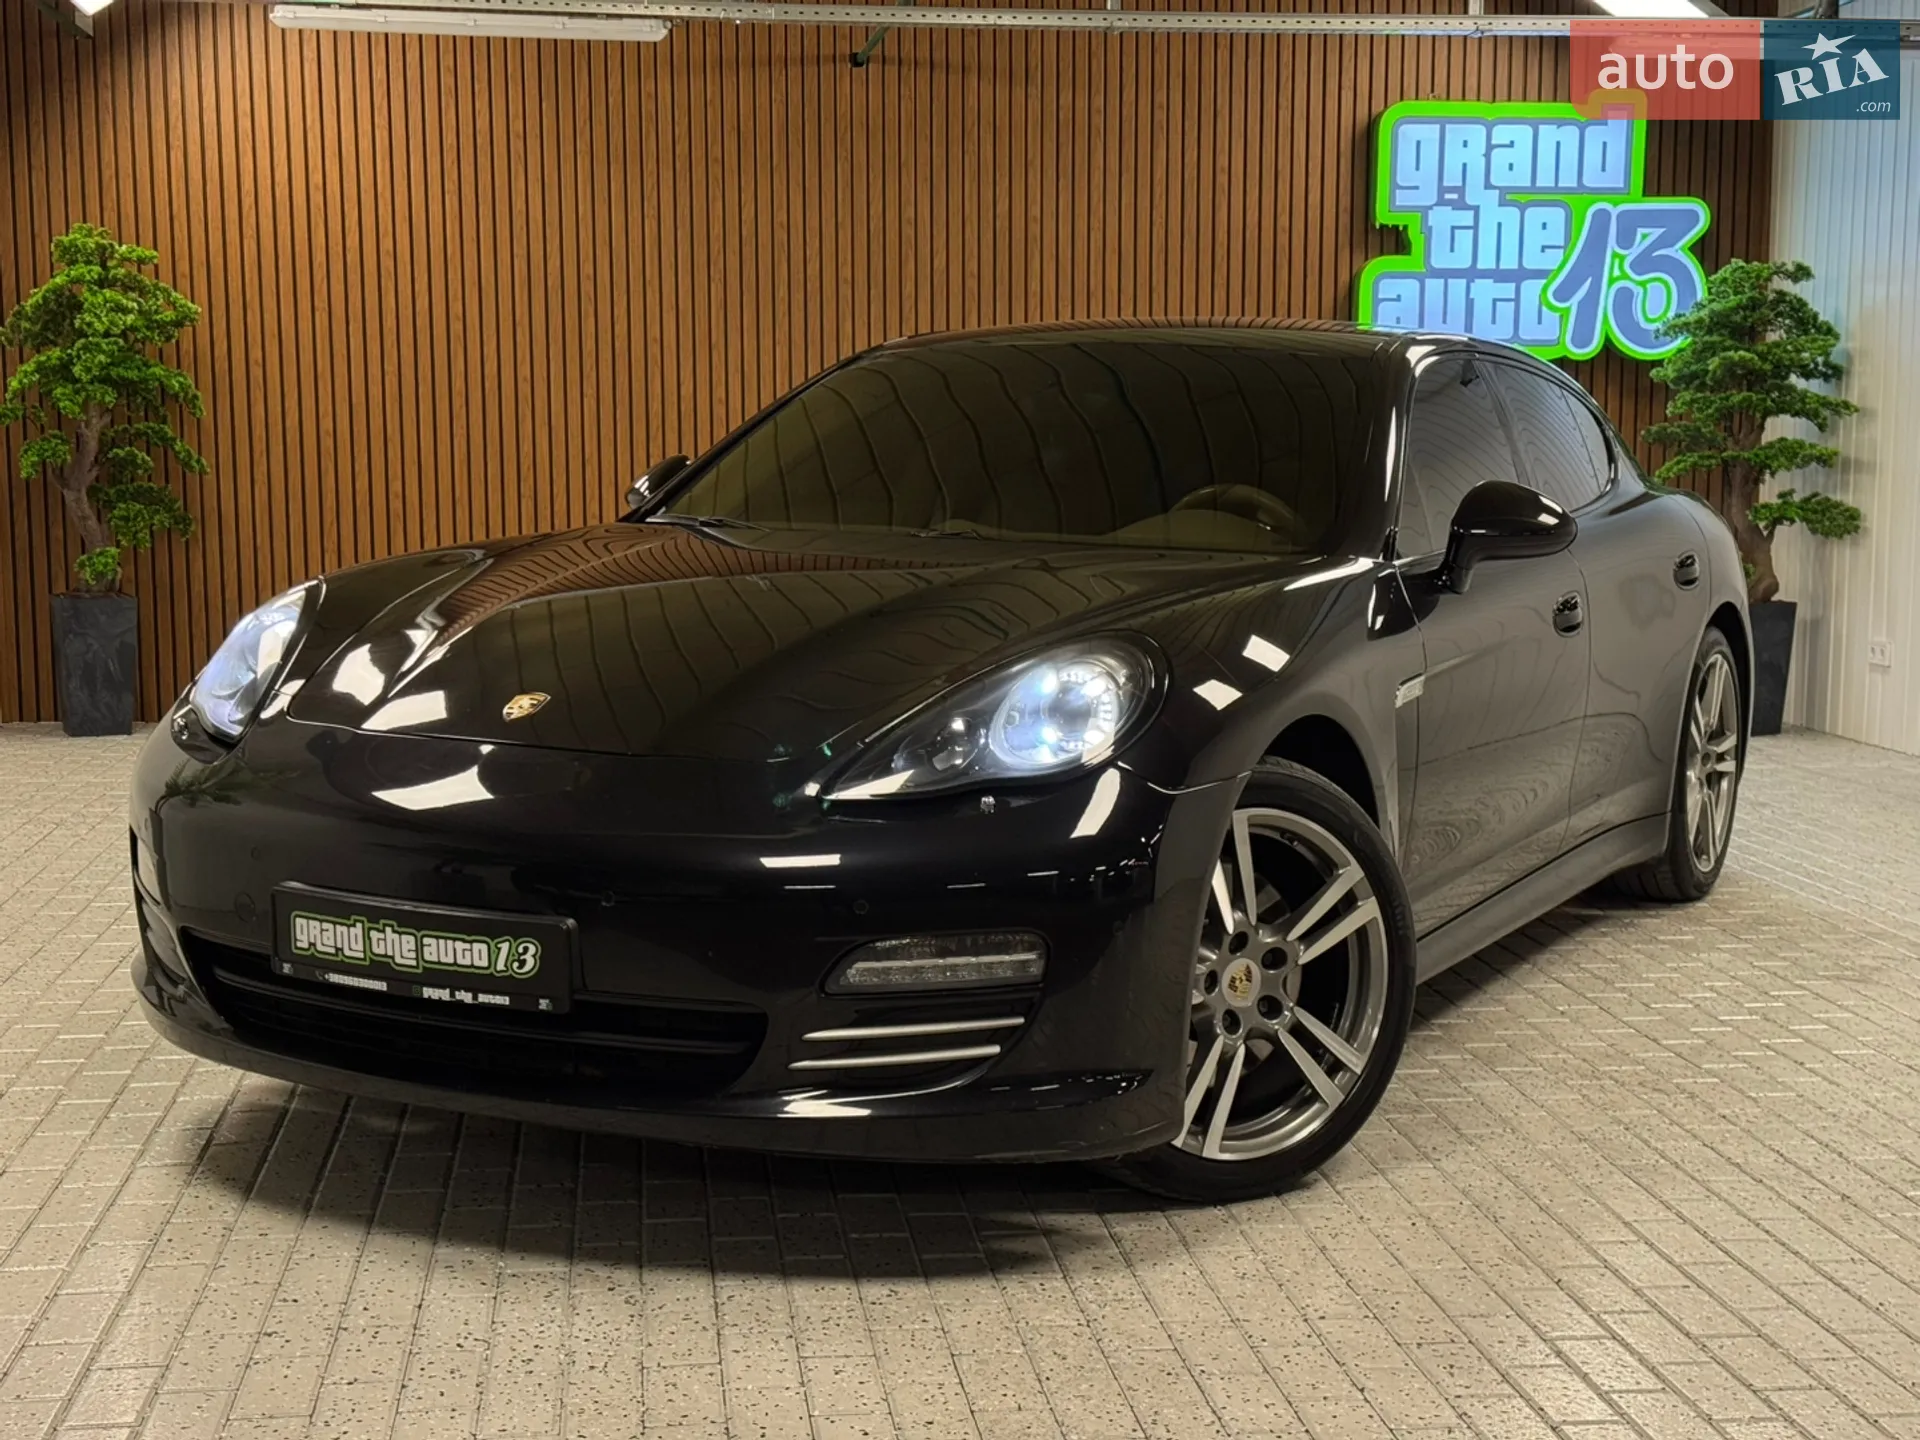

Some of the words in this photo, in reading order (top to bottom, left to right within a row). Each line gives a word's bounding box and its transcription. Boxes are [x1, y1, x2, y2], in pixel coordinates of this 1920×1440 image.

[1428, 188, 1566, 270] the
[1377, 278, 1562, 340] auto
[369, 926, 417, 967] the
